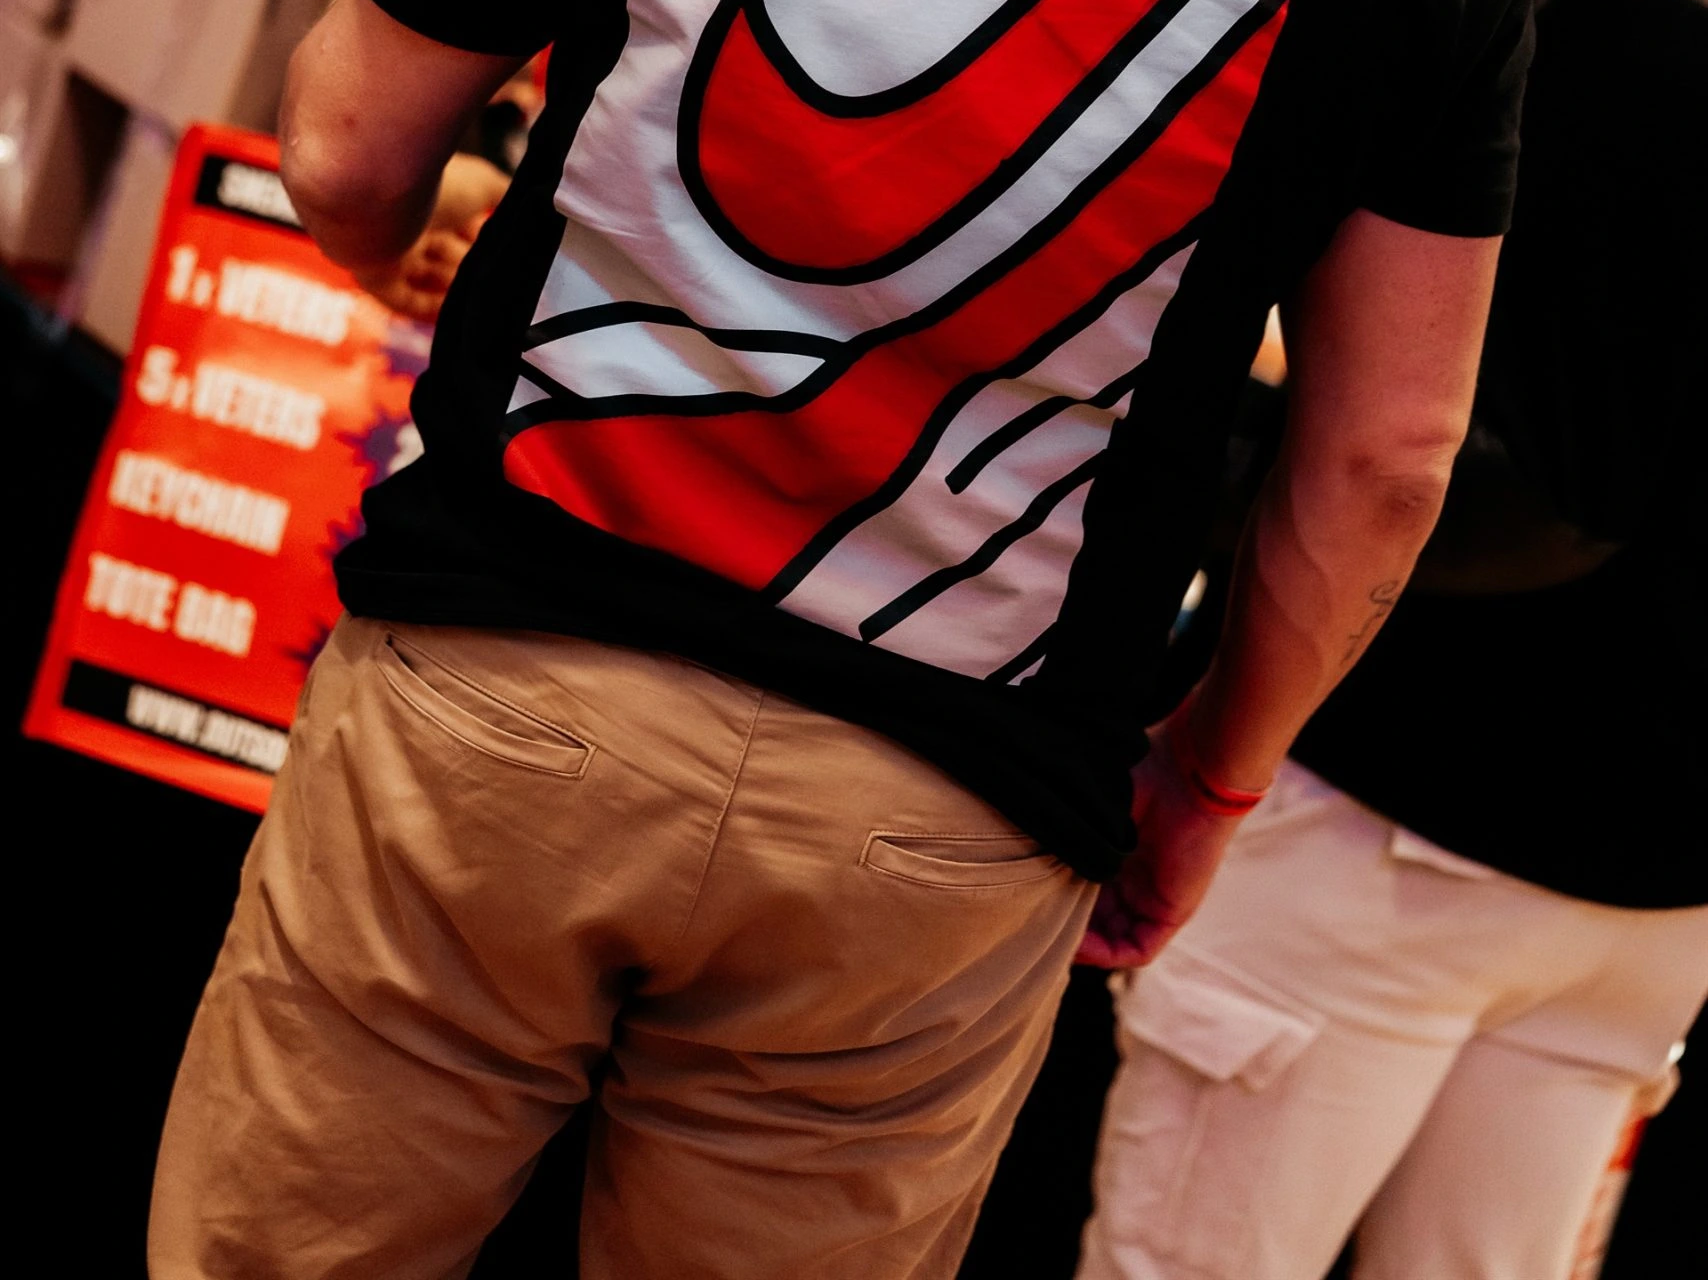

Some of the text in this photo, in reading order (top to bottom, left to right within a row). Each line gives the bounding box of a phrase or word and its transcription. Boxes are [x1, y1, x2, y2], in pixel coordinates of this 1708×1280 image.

[193, 361, 325, 450] VETERS
[110, 449, 290, 556] KEYCHAIN
[85, 552, 257, 658] TOTE BAG
